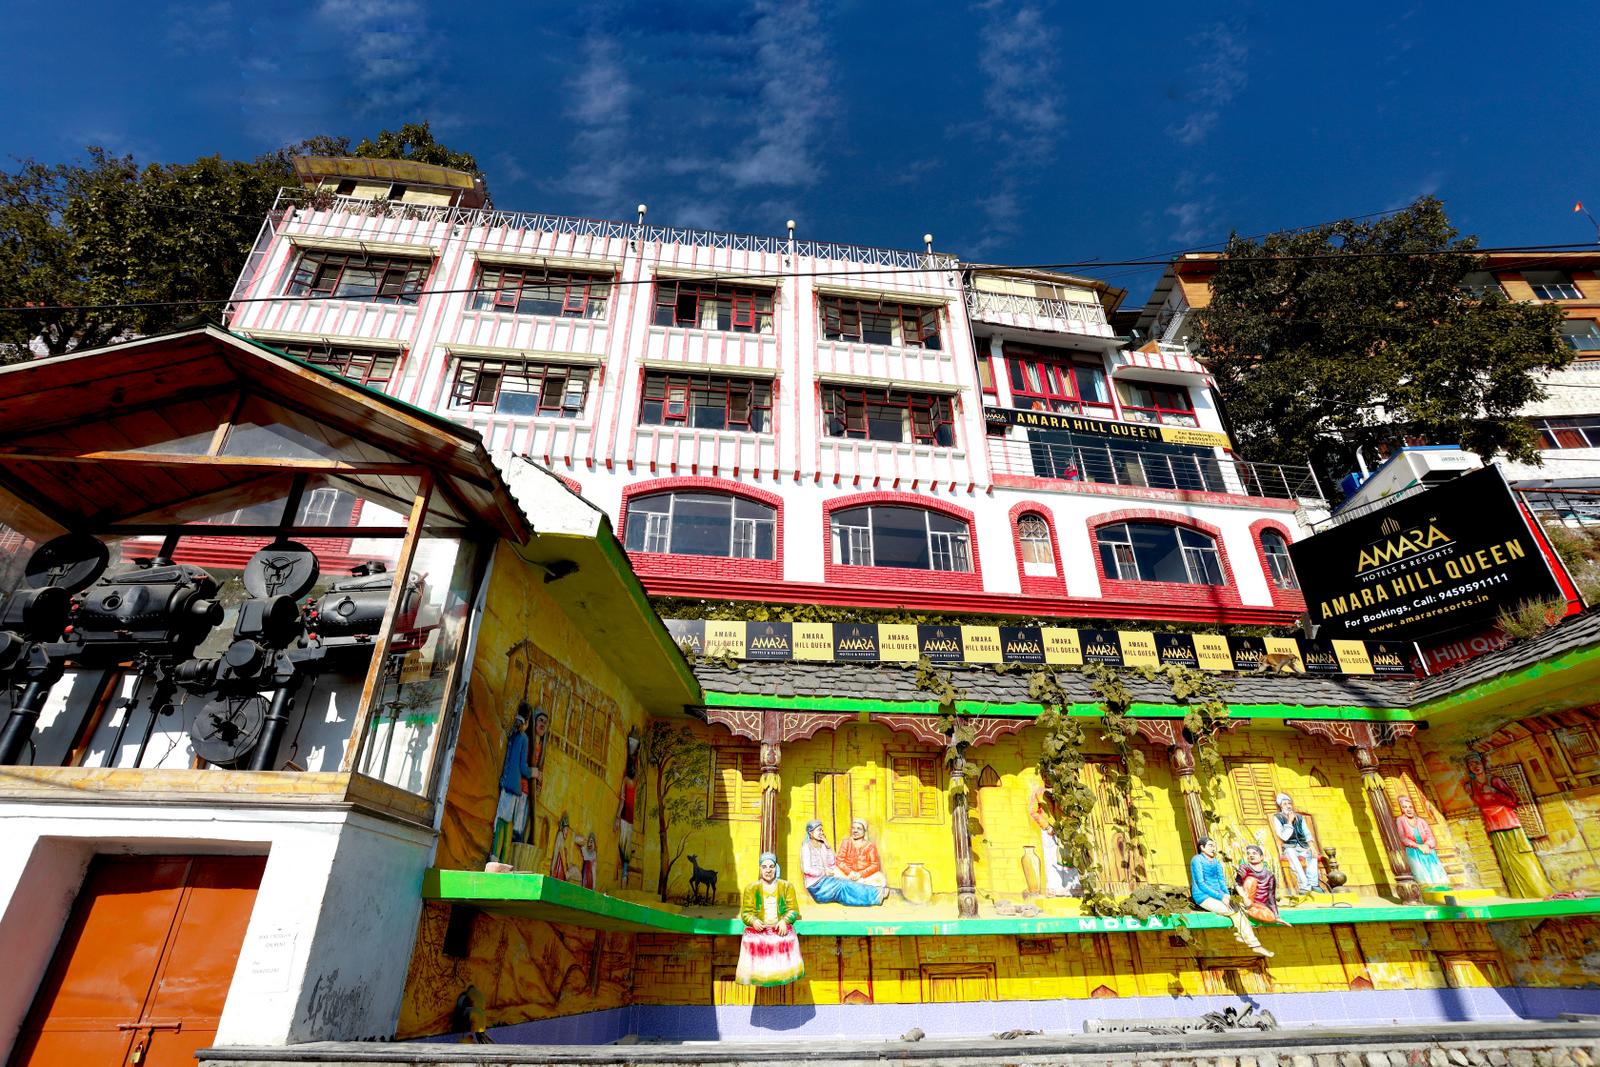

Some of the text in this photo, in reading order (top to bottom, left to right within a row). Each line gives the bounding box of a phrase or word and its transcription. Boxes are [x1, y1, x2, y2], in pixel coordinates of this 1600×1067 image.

[1017, 413, 1158, 439] AMARA HILL QUEEN
[1358, 524, 1451, 572] AMARA
[1362, 566, 1397, 582] HOTELS
[1410, 547, 1454, 567] RESORTS
[1321, 538, 1525, 619] AMARA HILL QUEEN
[1345, 573, 1508, 628] For Bookings, Call: 9459591111
[1369, 622, 1397, 634] www.
[752, 637, 788, 649] AMARA
[811, 641, 831, 649] QUEEN
[839, 638, 875, 650] AMARA
[924, 640, 959, 651] AMARA
[1007, 642, 1040, 653] AMARA
[1086, 644, 1119, 656] AMARA
[1162, 647, 1194, 659] AMARA
[1433, 641, 1468, 663] Hill
[1306, 653, 1336, 664] AMARA
[1373, 655, 1402, 665] AMARA
